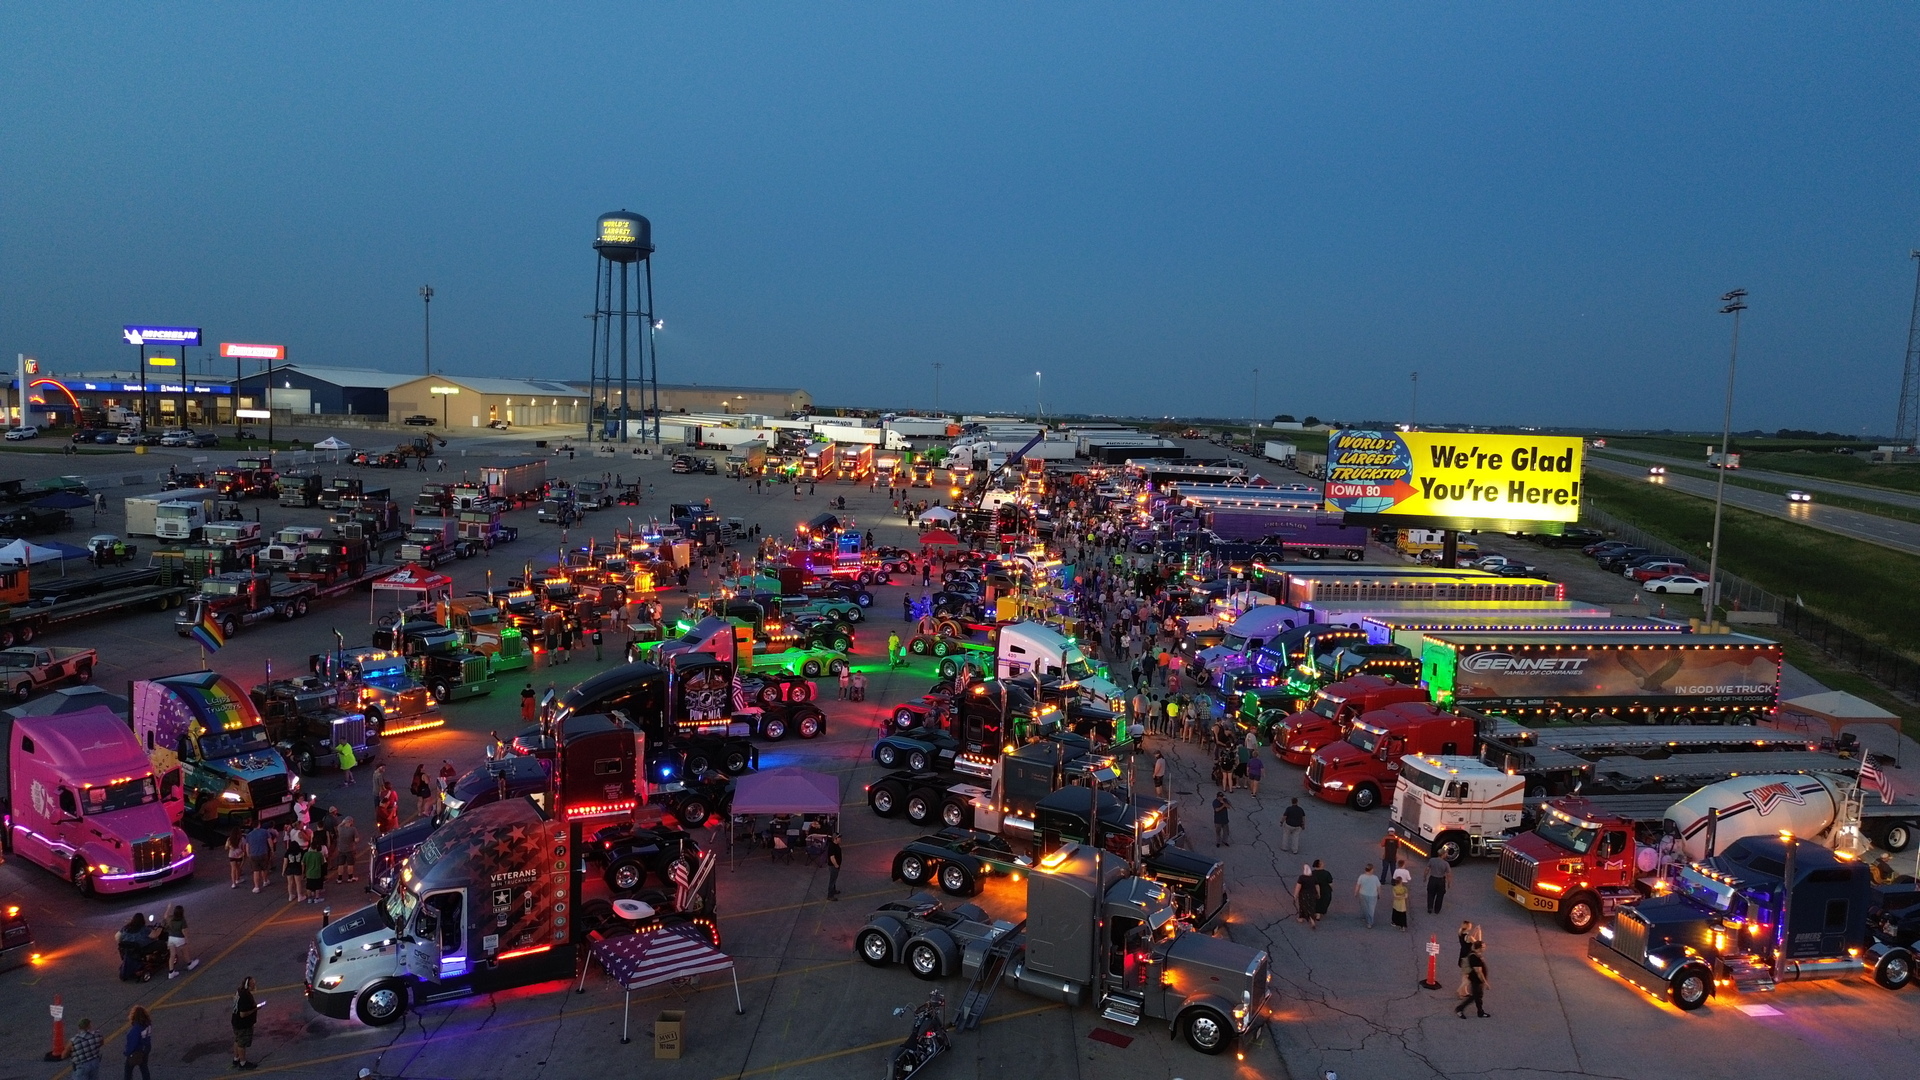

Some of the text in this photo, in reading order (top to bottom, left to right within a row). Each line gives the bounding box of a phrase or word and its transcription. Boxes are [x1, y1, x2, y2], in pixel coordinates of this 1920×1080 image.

[1338, 436, 1396, 450] WORLD'S
[1339, 452, 1396, 465] LARGEST
[1430, 445, 1573, 473] We're Glad
[1331, 467, 1407, 480] TRUCKSTOP
[1331, 485, 1380, 496] IOWA 80
[1420, 477, 1579, 506] You're Here!
[1473, 658, 1588, 670] BENNETT
[1675, 685, 1772, 694] IN GOD WE TRUCK
[708, 708, 721, 720] MIA
[490, 868, 537, 882] VETERANS
[504, 877, 530, 886] TRUCKING
[1533, 897, 1554, 910] 309
